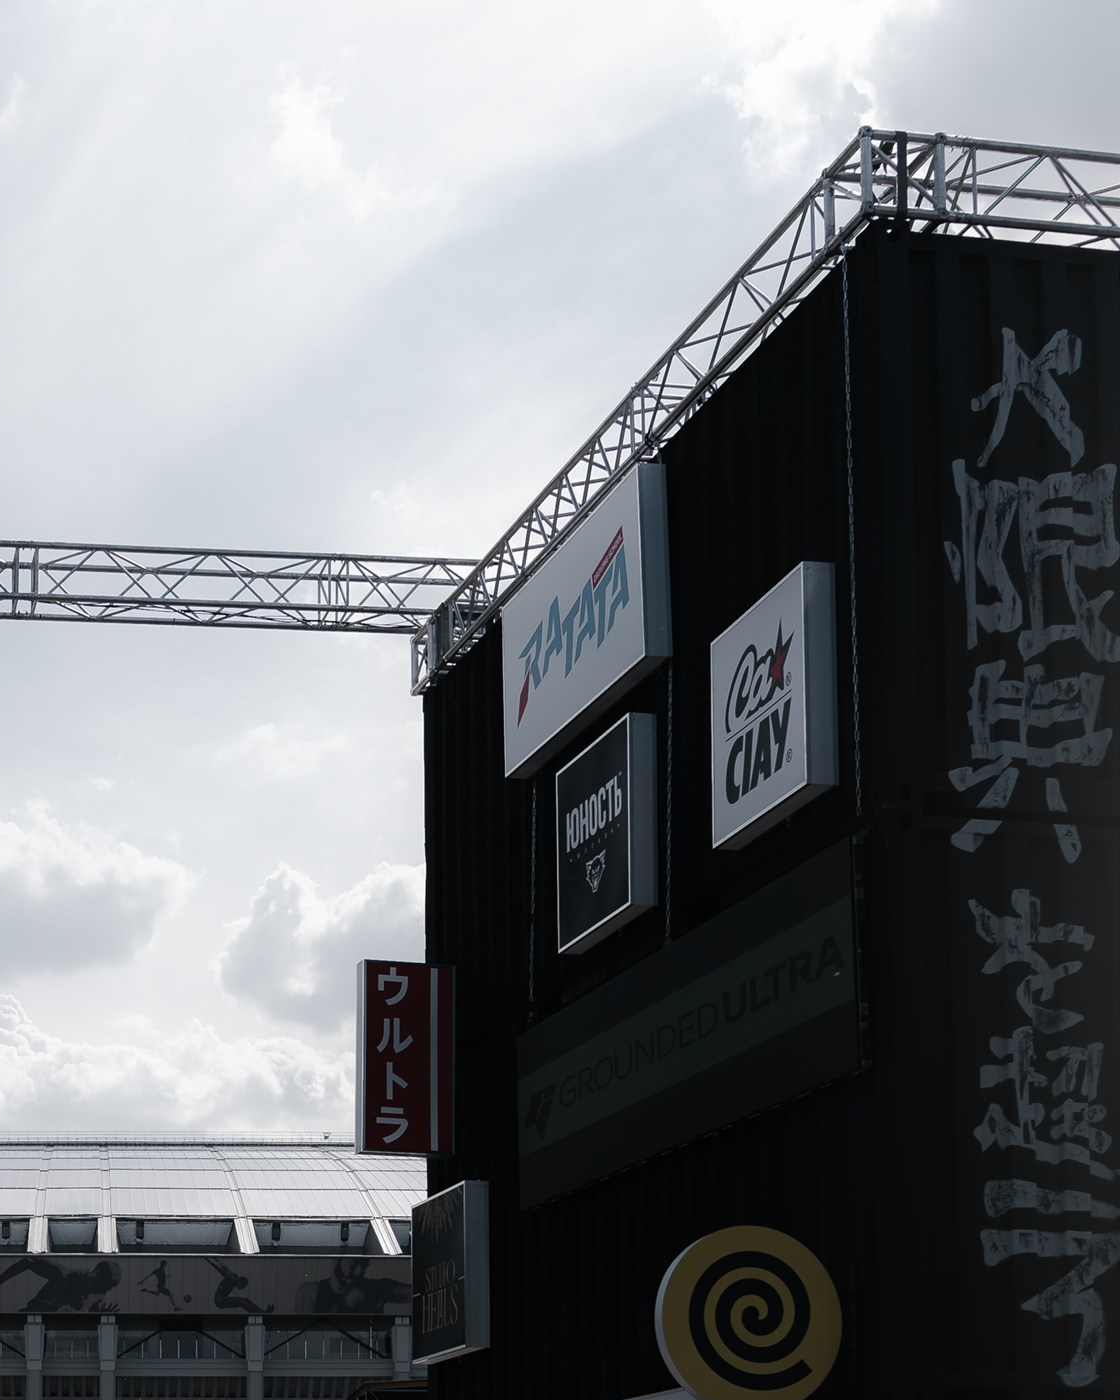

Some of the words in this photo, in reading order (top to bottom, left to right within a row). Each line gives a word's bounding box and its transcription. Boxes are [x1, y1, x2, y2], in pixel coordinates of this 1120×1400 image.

[518, 543, 630, 691] RATATA
[566, 775, 623, 853] ЮНОСТЬ
[376, 966, 414, 1144] ウルトラ
